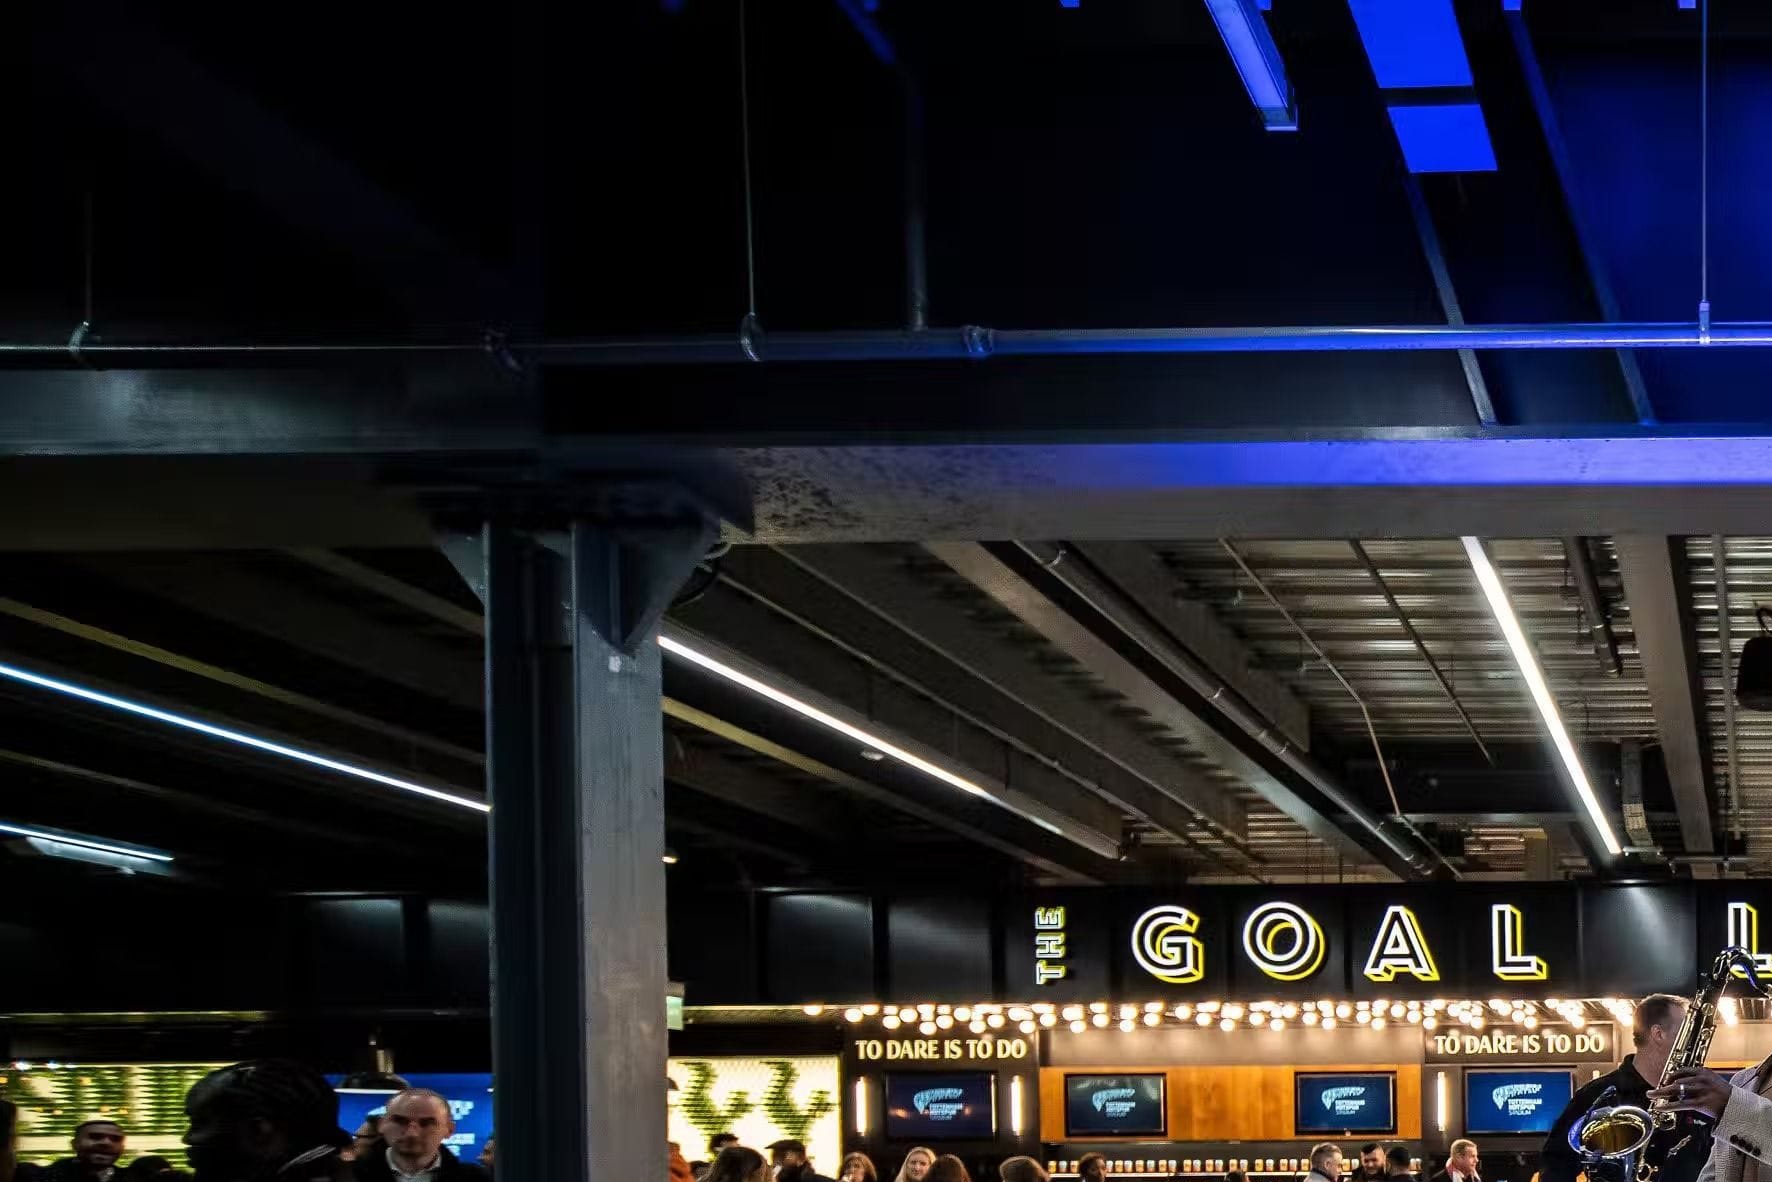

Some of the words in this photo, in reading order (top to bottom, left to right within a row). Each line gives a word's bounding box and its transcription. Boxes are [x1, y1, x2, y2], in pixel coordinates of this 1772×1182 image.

[1035, 906, 1066, 985] THE
[1131, 901, 1549, 984] GOAL
[855, 1040, 883, 1060] TO
[886, 1039, 940, 1060] DARE
[944, 1039, 963, 1059] IS
[966, 1039, 993, 1059] TO
[996, 1038, 1027, 1059] DO
[1434, 1036, 1460, 1055] TO
[1465, 1035, 1519, 1054] DARE
[1522, 1035, 1541, 1053] IS
[1544, 1035, 1571, 1053] TO
[1575, 1034, 1605, 1053] DO
